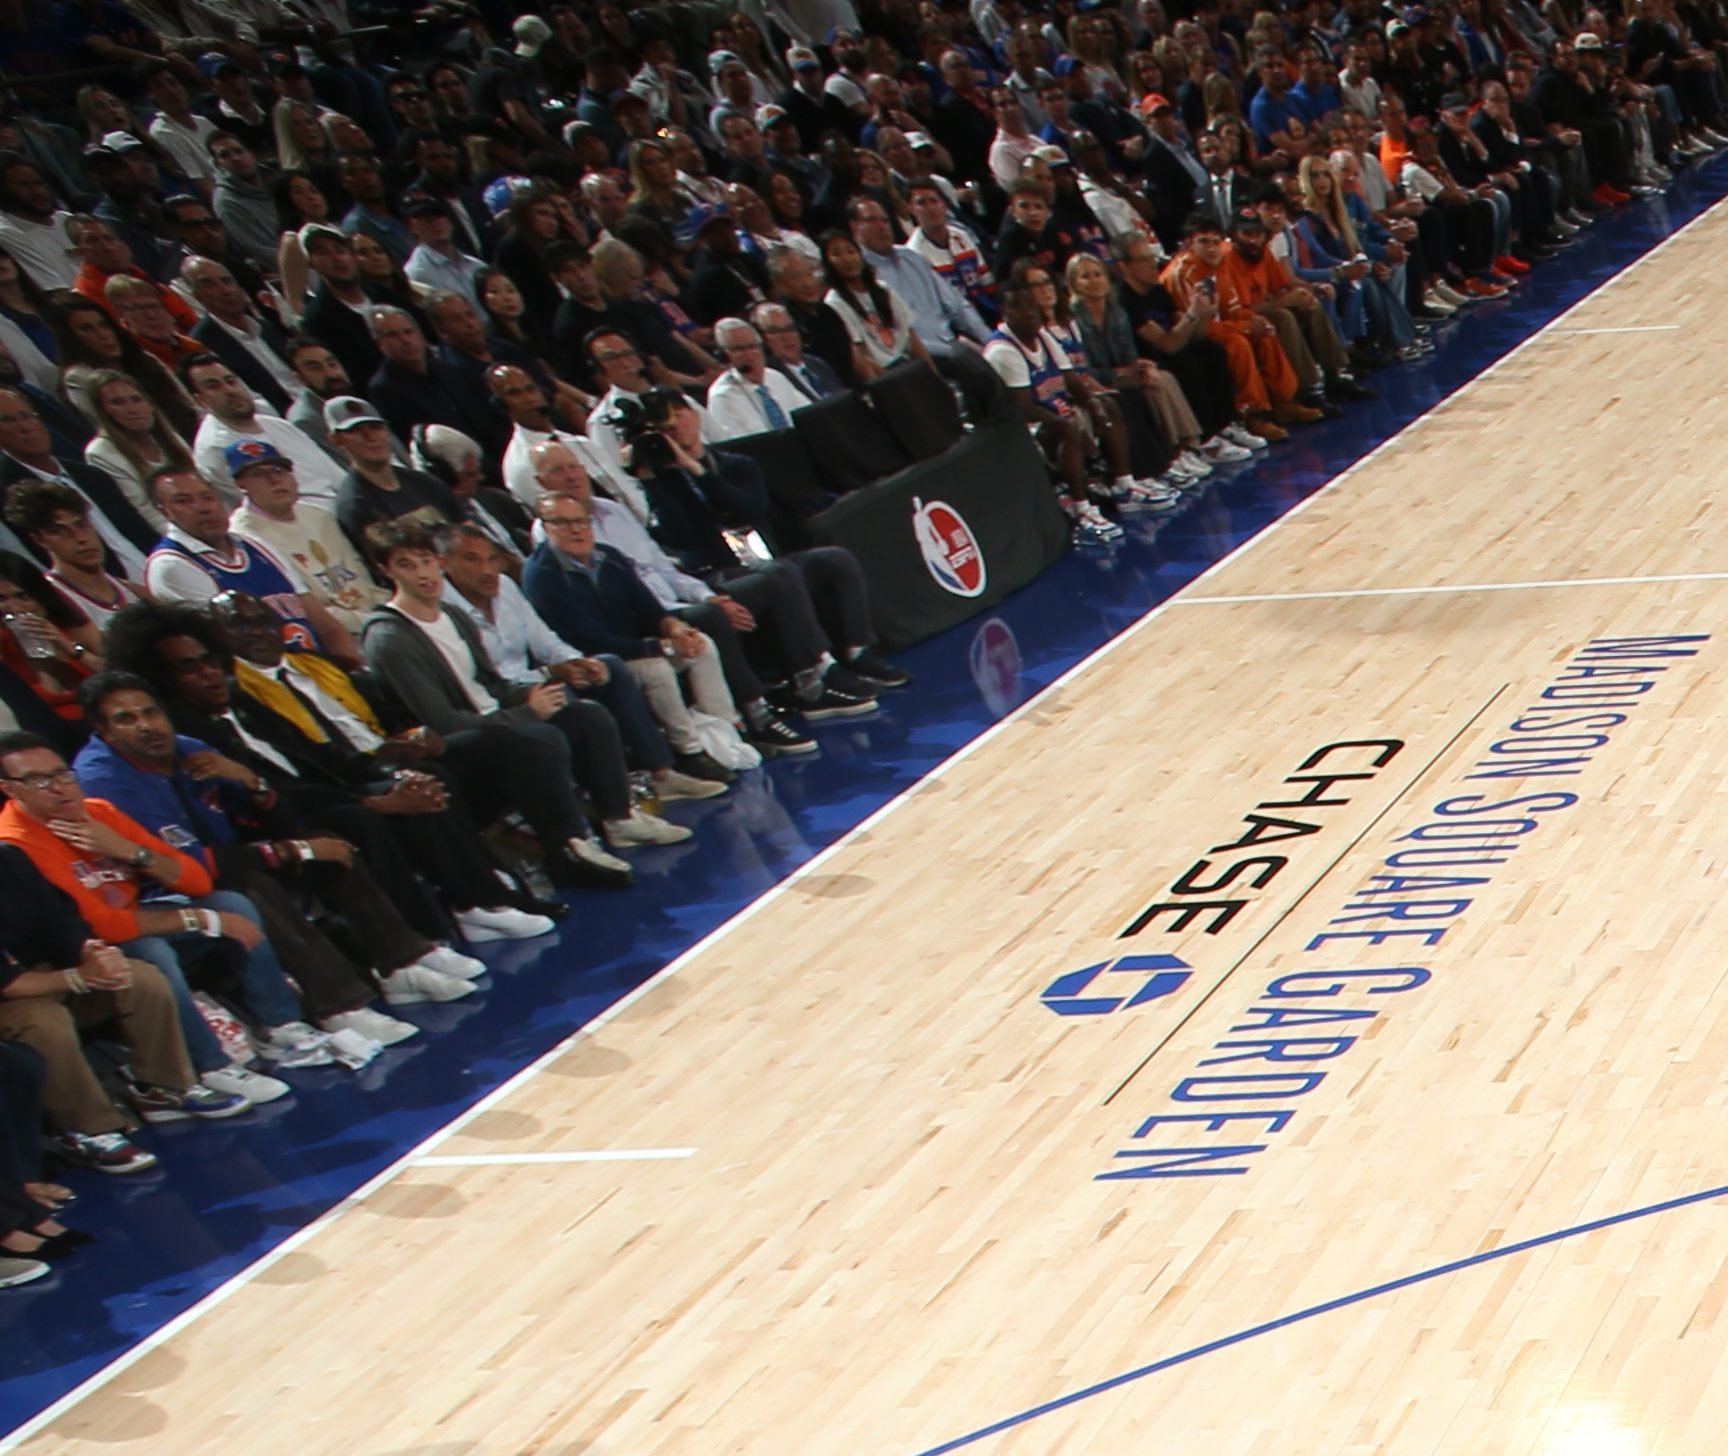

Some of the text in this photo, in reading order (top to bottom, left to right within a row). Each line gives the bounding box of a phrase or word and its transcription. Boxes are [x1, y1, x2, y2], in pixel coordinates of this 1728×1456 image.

[1092, 633, 1712, 1181] MADISON SQUARE GARDEN
[1116, 738, 1406, 940] CHASE
